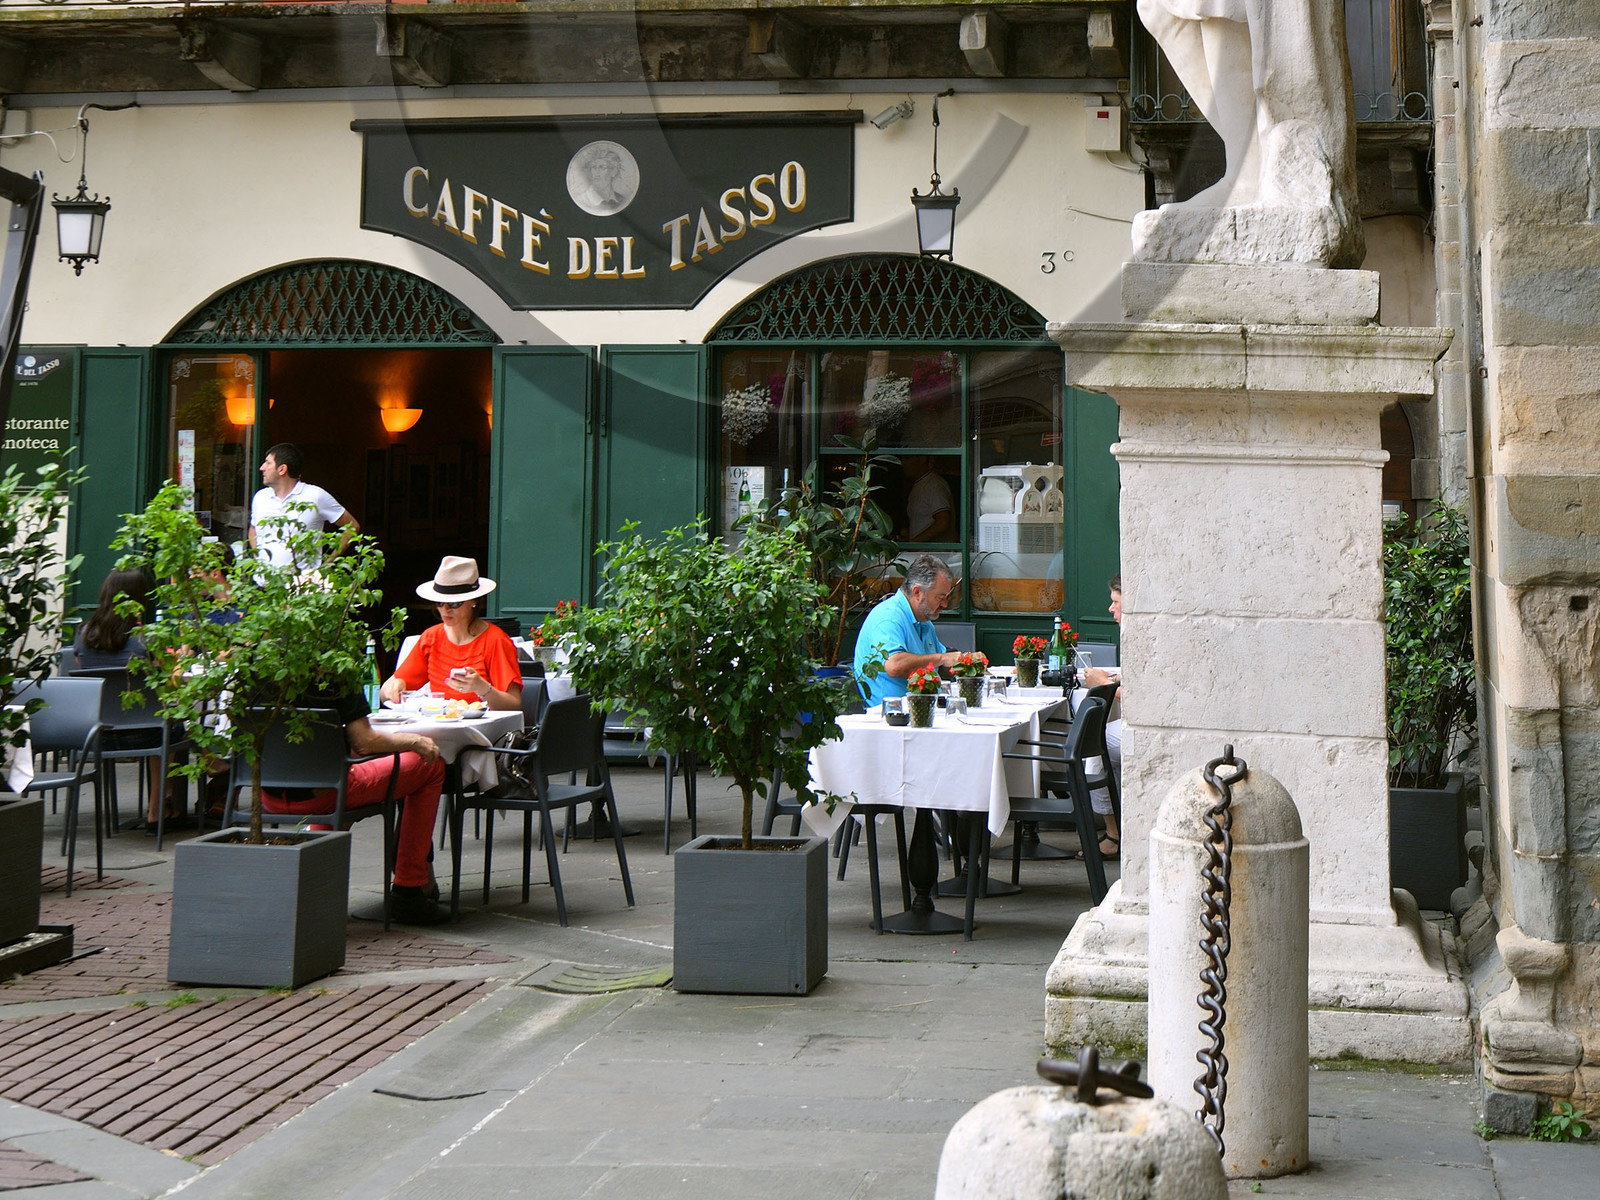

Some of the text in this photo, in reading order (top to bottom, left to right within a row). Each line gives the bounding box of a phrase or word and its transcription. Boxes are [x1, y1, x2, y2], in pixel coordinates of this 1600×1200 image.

[403, 161, 807, 279] CAFFÈ DEL TASSO
[38, 358, 60, 375] TASSO
[5, 417, 70, 430] storante
[1, 437, 59, 449] noteca
